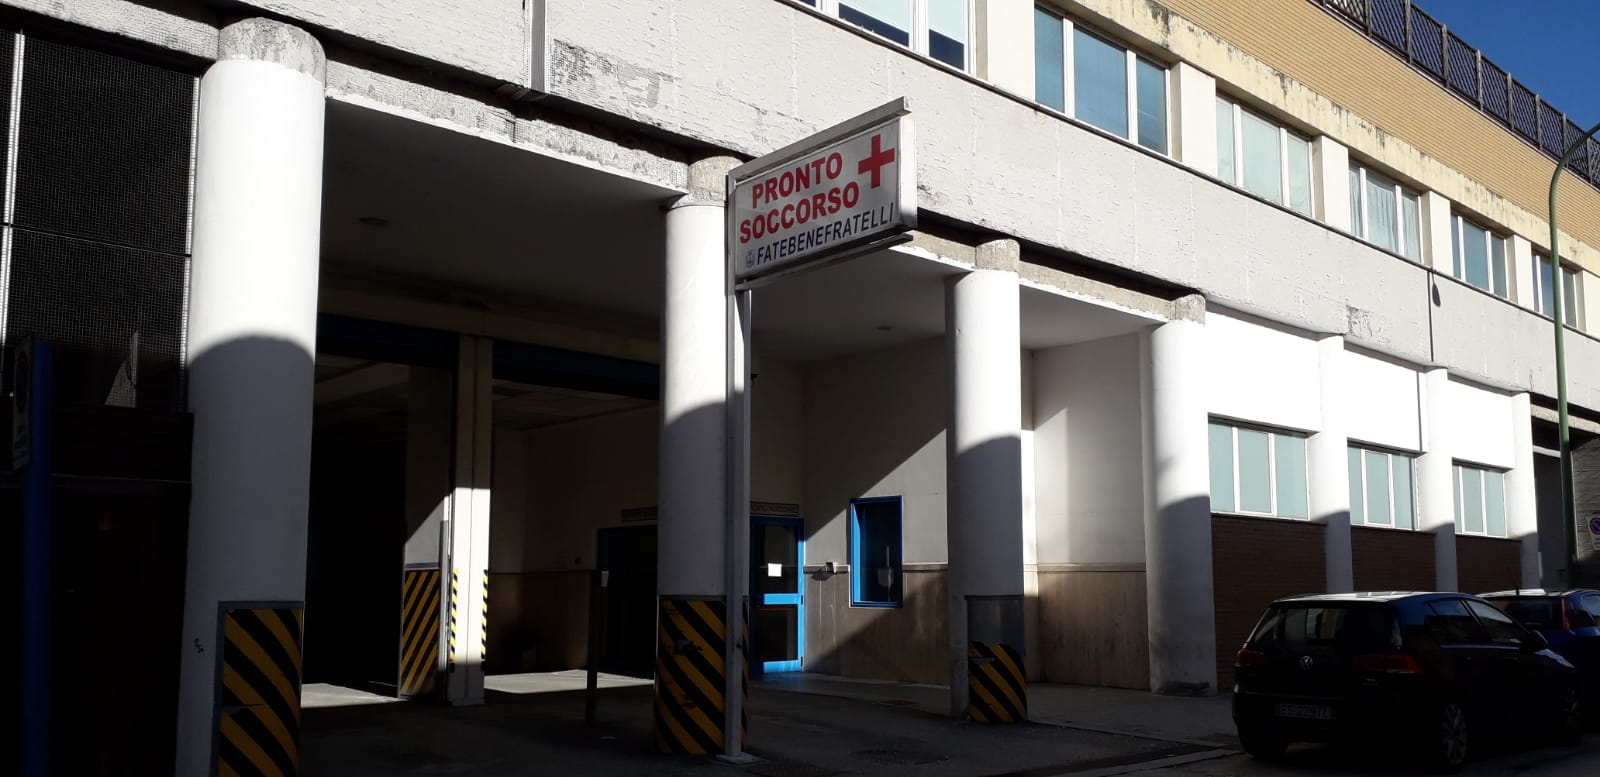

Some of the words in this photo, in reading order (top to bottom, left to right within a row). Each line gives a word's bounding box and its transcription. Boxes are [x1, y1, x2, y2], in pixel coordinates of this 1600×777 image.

[752, 152, 842, 208] PRONTO
[740, 182, 859, 244] SOCCORSO
[757, 202, 894, 264] FATEBENEFRATELLI
